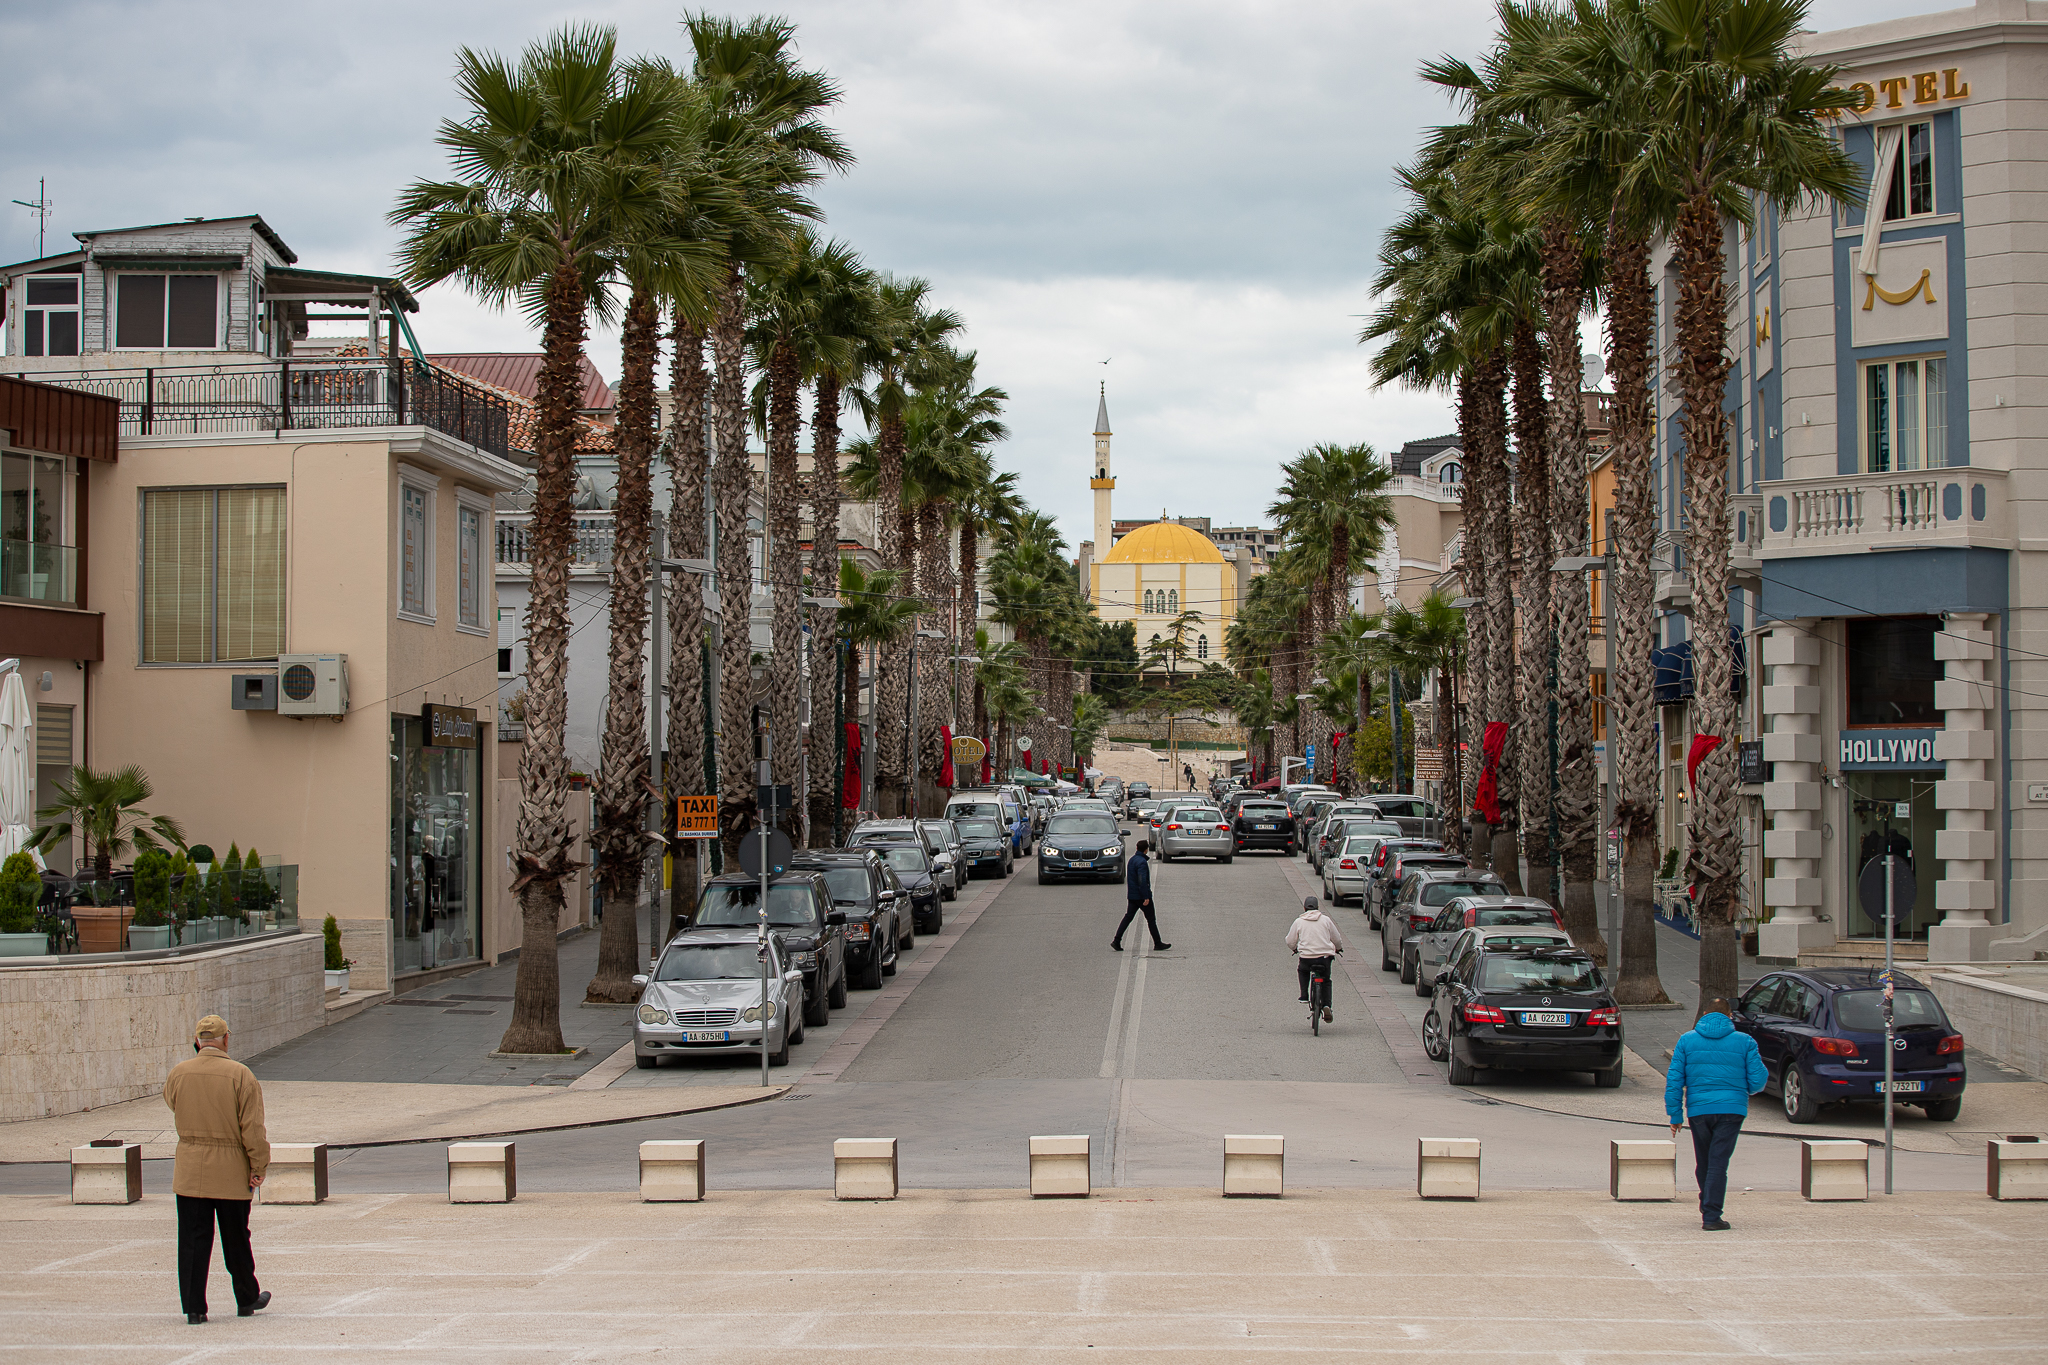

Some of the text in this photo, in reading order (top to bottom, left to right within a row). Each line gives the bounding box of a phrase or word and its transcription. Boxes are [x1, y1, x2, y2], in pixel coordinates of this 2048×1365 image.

[681, 799, 714, 813] TAXI
[681, 816, 716, 828] AB 777 T
[1527, 1014, 1537, 1022] AA
[689, 1033, 698, 1041] AA
